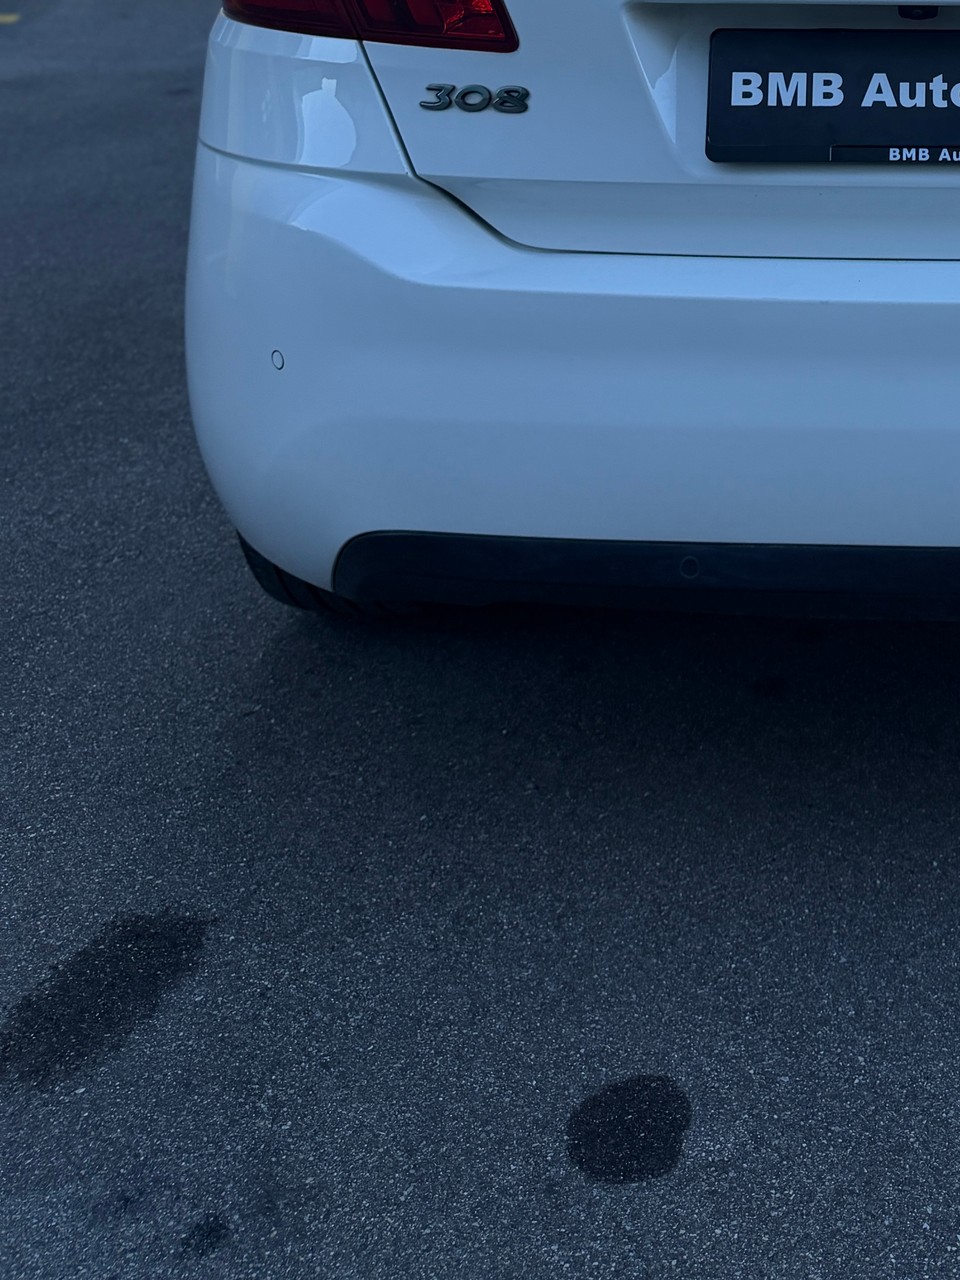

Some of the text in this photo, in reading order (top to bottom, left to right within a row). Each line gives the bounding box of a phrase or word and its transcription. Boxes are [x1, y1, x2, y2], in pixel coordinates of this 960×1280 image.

[419, 83, 531, 114] 308
[730, 71, 845, 108] BMB
[888, 147, 930, 162] BMB
